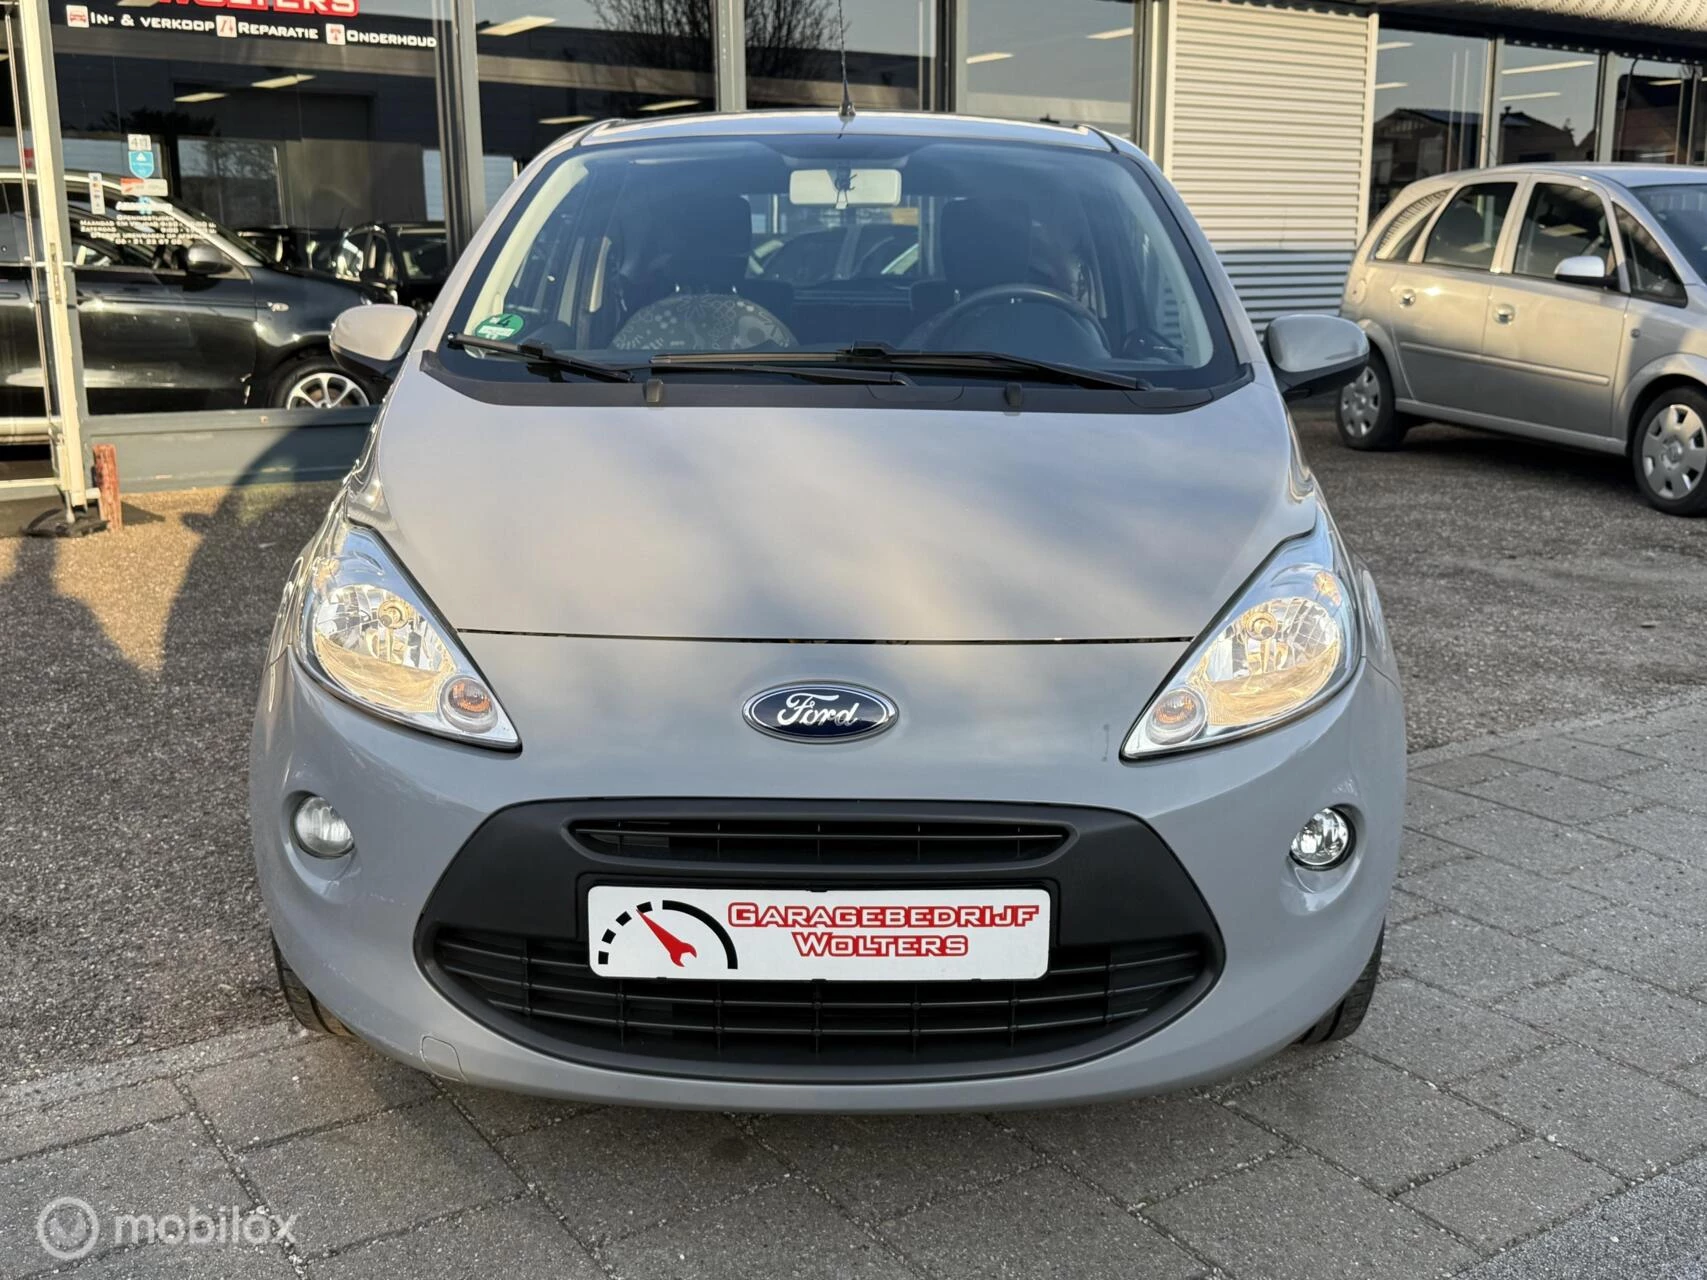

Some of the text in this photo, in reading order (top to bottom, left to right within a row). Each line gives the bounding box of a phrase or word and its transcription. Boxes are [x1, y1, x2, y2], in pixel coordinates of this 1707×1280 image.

[120, 13, 135, 27] &
[140, 17, 215, 32] VERKOOP
[238, 22, 319, 40] REPARATIE
[347, 30, 437, 47] ONDERHOUD
[777, 692, 860, 726] Ford
[728, 902, 1040, 928] GARAGEBEDRIJF
[792, 932, 969, 957] WOLTERS
